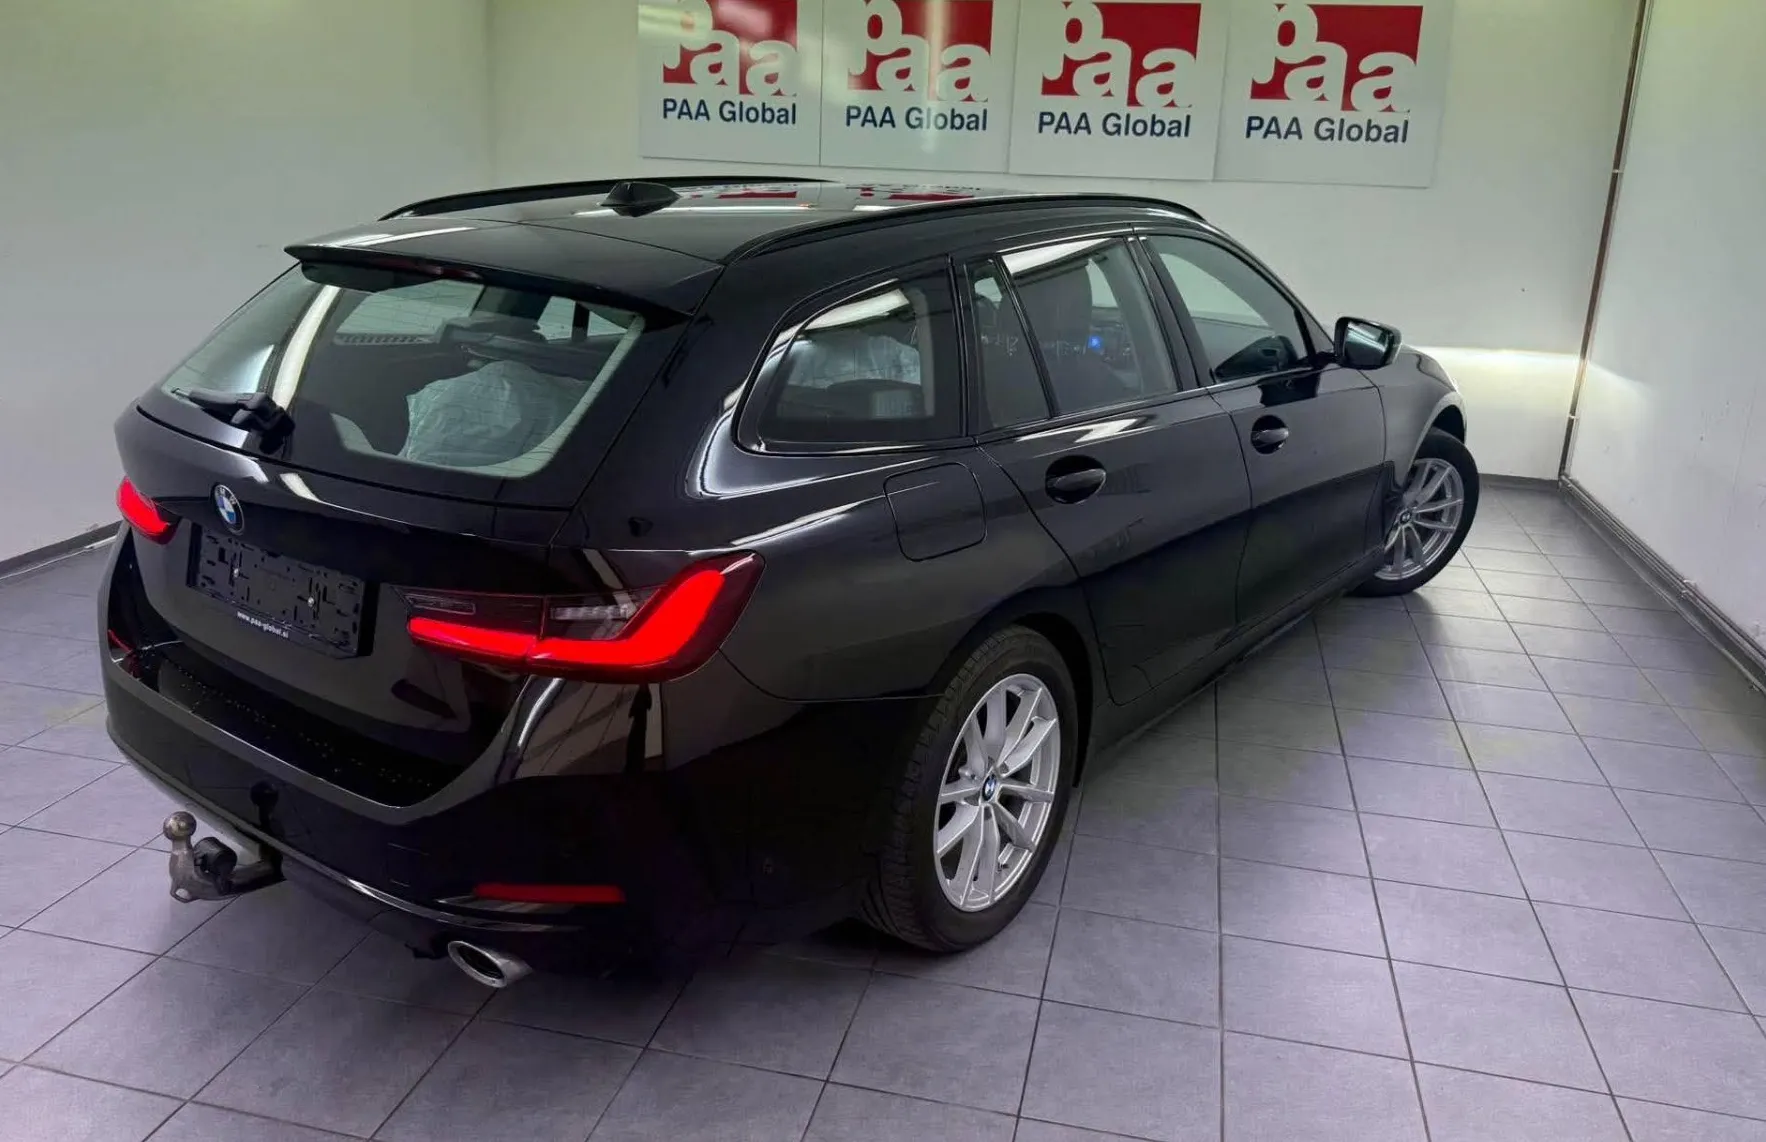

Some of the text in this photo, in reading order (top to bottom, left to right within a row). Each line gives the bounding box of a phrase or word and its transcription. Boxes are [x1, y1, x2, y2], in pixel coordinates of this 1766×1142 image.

[1041, 2, 1199, 107] paa
[1250, 4, 1417, 113] paa
[663, 98, 796, 125] PAA Global
[846, 105, 988, 131] PAA Global
[1037, 111, 1191, 138] PAA Global
[1245, 116, 1409, 143] PAA Global
